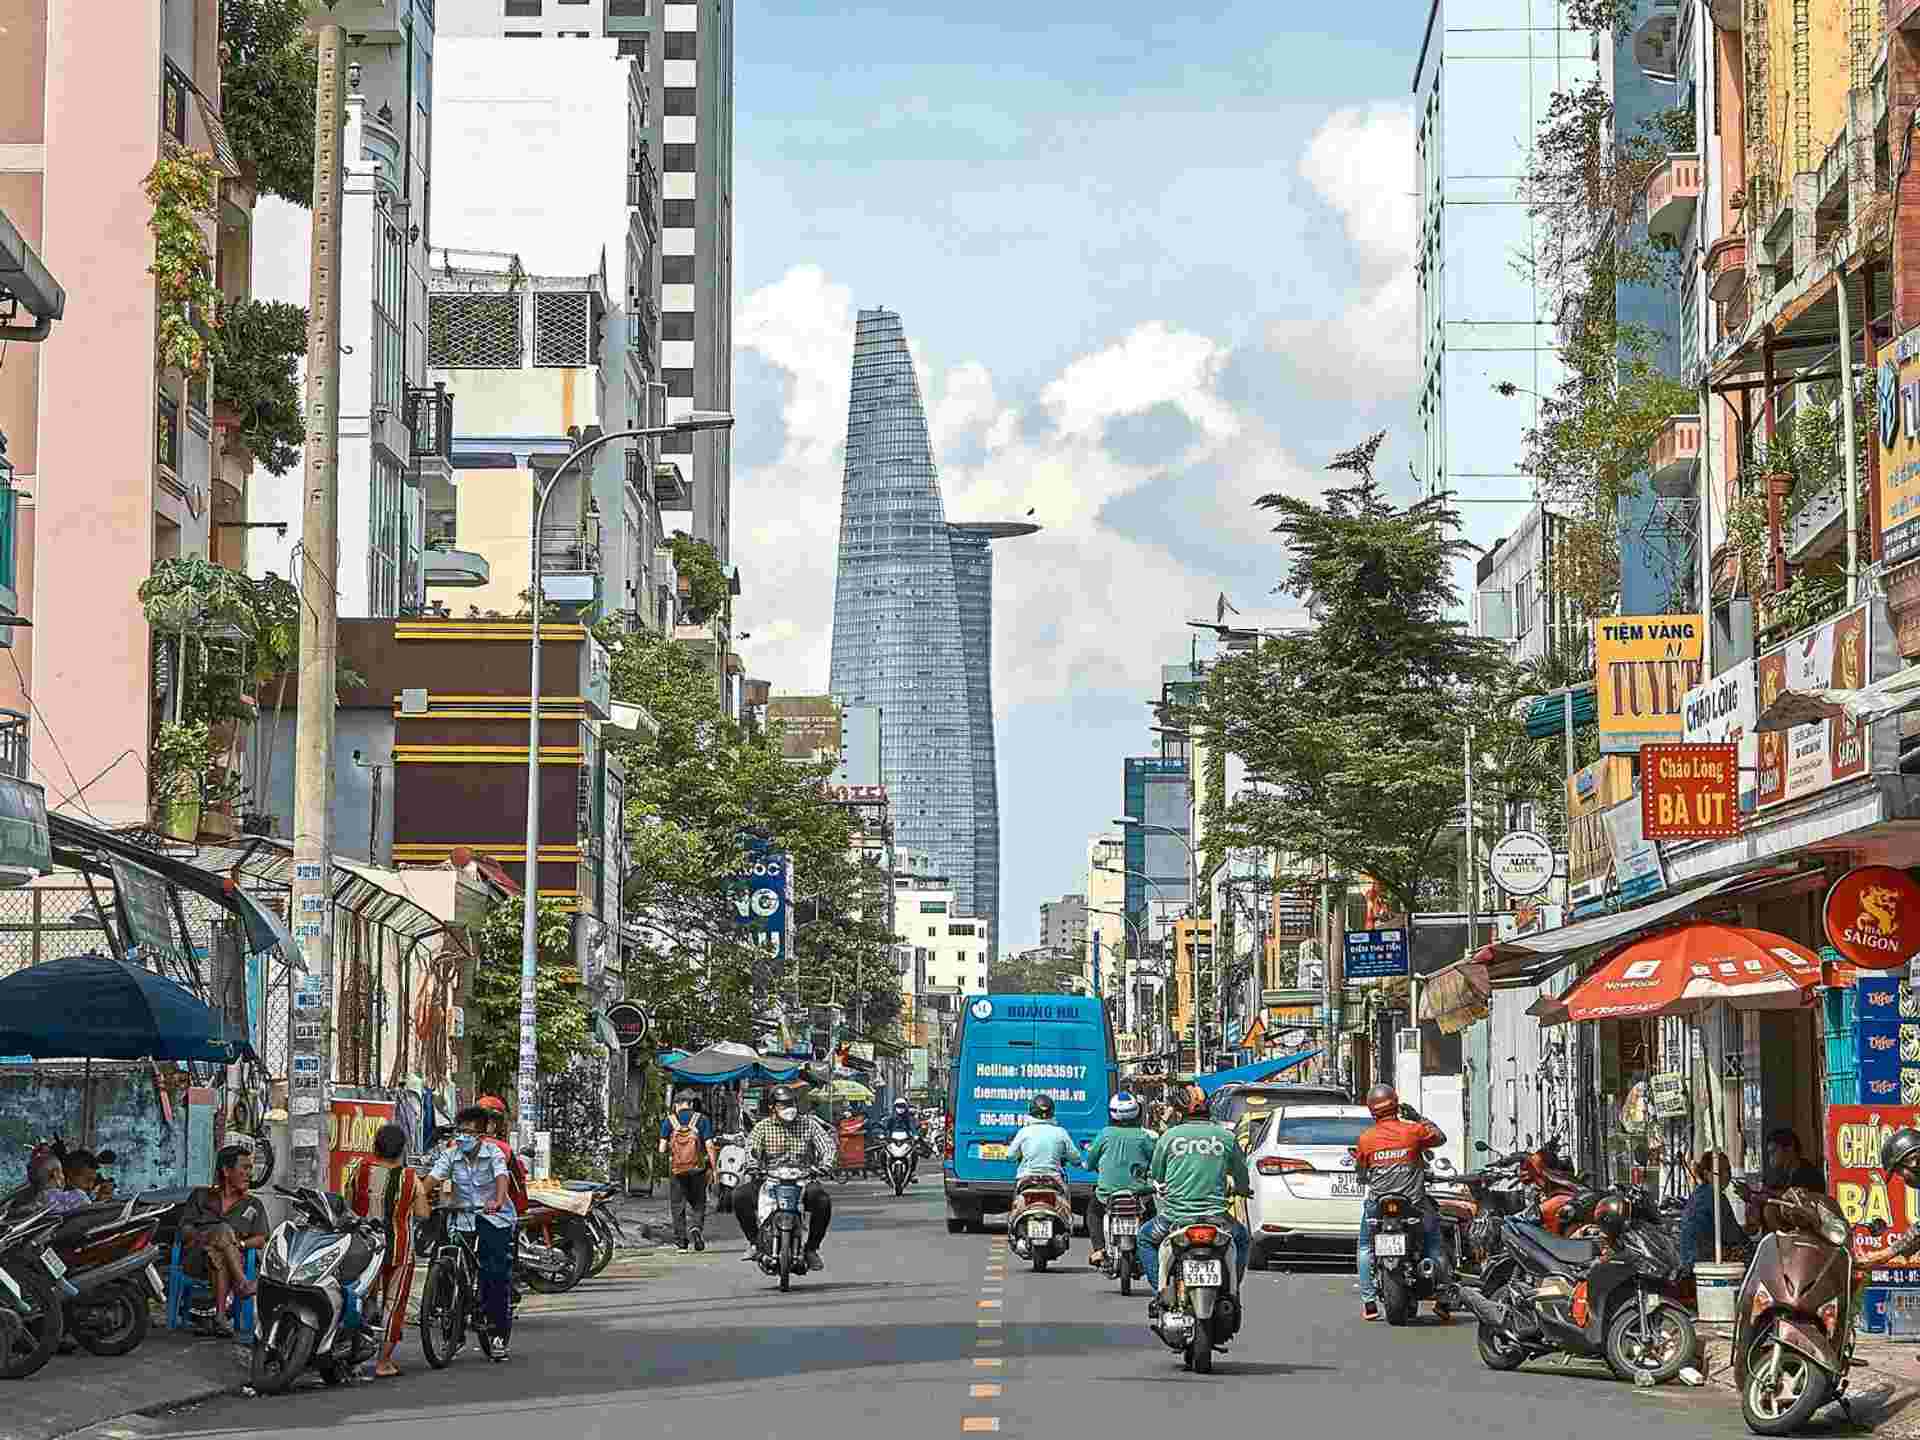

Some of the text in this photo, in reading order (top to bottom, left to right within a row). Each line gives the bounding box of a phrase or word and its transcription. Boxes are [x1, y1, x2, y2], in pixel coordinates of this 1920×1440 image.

[1603, 620, 1694, 644] TIỆM VÀNG
[1686, 678, 1739, 733] CHÁO LÒNG
[1659, 756, 1724, 784] Cháo Lòng
[1658, 784, 1727, 826] BÀ ÚT
[1843, 928, 1899, 952] SAIGON
[1172, 1136, 1225, 1156] Grab
[1837, 1169, 1893, 1227] BÀ
